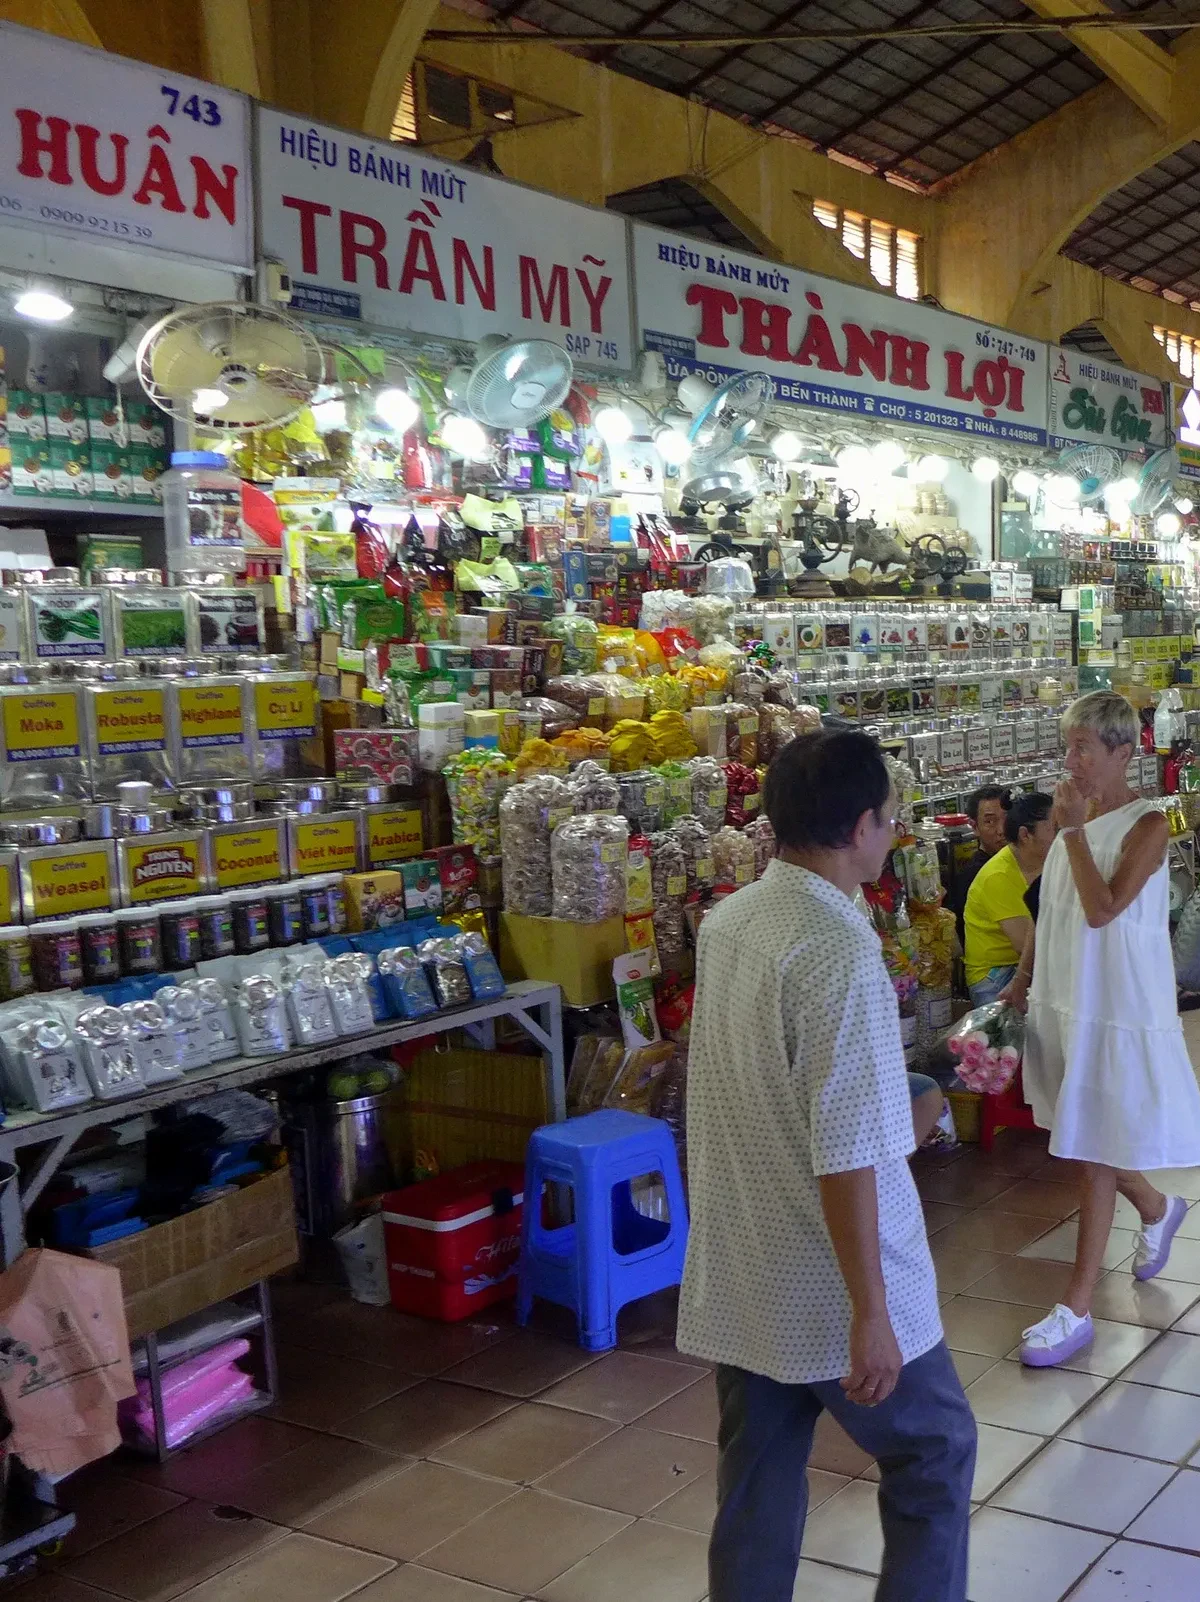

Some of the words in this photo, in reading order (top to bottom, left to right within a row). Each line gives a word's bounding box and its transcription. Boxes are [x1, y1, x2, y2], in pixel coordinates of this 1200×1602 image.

[160, 84, 222, 127] 743
[15, 107, 239, 227] HUÂN
[280, 125, 338, 171] HIỆU
[348, 145, 410, 188] BÁNH
[421, 167, 467, 203] MỨT
[39, 204, 84, 224] 0909
[88, 216, 109, 231] 92
[113, 219, 130, 235] 15
[135, 225, 153, 239] 39
[281, 194, 496, 312] TRẦN
[519, 253, 613, 334] MỸ
[658, 243, 700, 271] HIỆU
[705, 254, 752, 284] BÁNH
[756, 268, 790, 293] MỨT
[566, 334, 591, 359] SẠP
[596, 340, 618, 360] 745
[685, 283, 931, 392] THÀNH
[943, 350, 1025, 419] LỢI
[1079, 362, 1099, 380] HIỆU
[781, 382, 810, 401] BẾN
[813, 390, 858, 409] THÀNH
[924, 410, 958, 427] 201323
[196, 691, 224, 700] Coffee
[271, 686, 297, 694] Coffee
[23, 699, 57, 709] Coffee
[113, 695, 144, 705] Coffee
[269, 702, 287, 714] Cu
[98, 711, 162, 728] Robusta
[182, 705, 241, 724] Highland
[20, 718, 64, 732] Moka
[383, 816, 407, 825] Coffee
[312, 827, 340, 837] Coffee
[371, 830, 420, 848] Arabica
[232, 837, 261, 848] Coffee
[328, 843, 354, 856] Nam
[148, 850, 180, 861] TRUNG
[217, 851, 279, 871] Coconut
[52, 860, 87, 872] Coffee
[37, 875, 106, 899] Weasel
